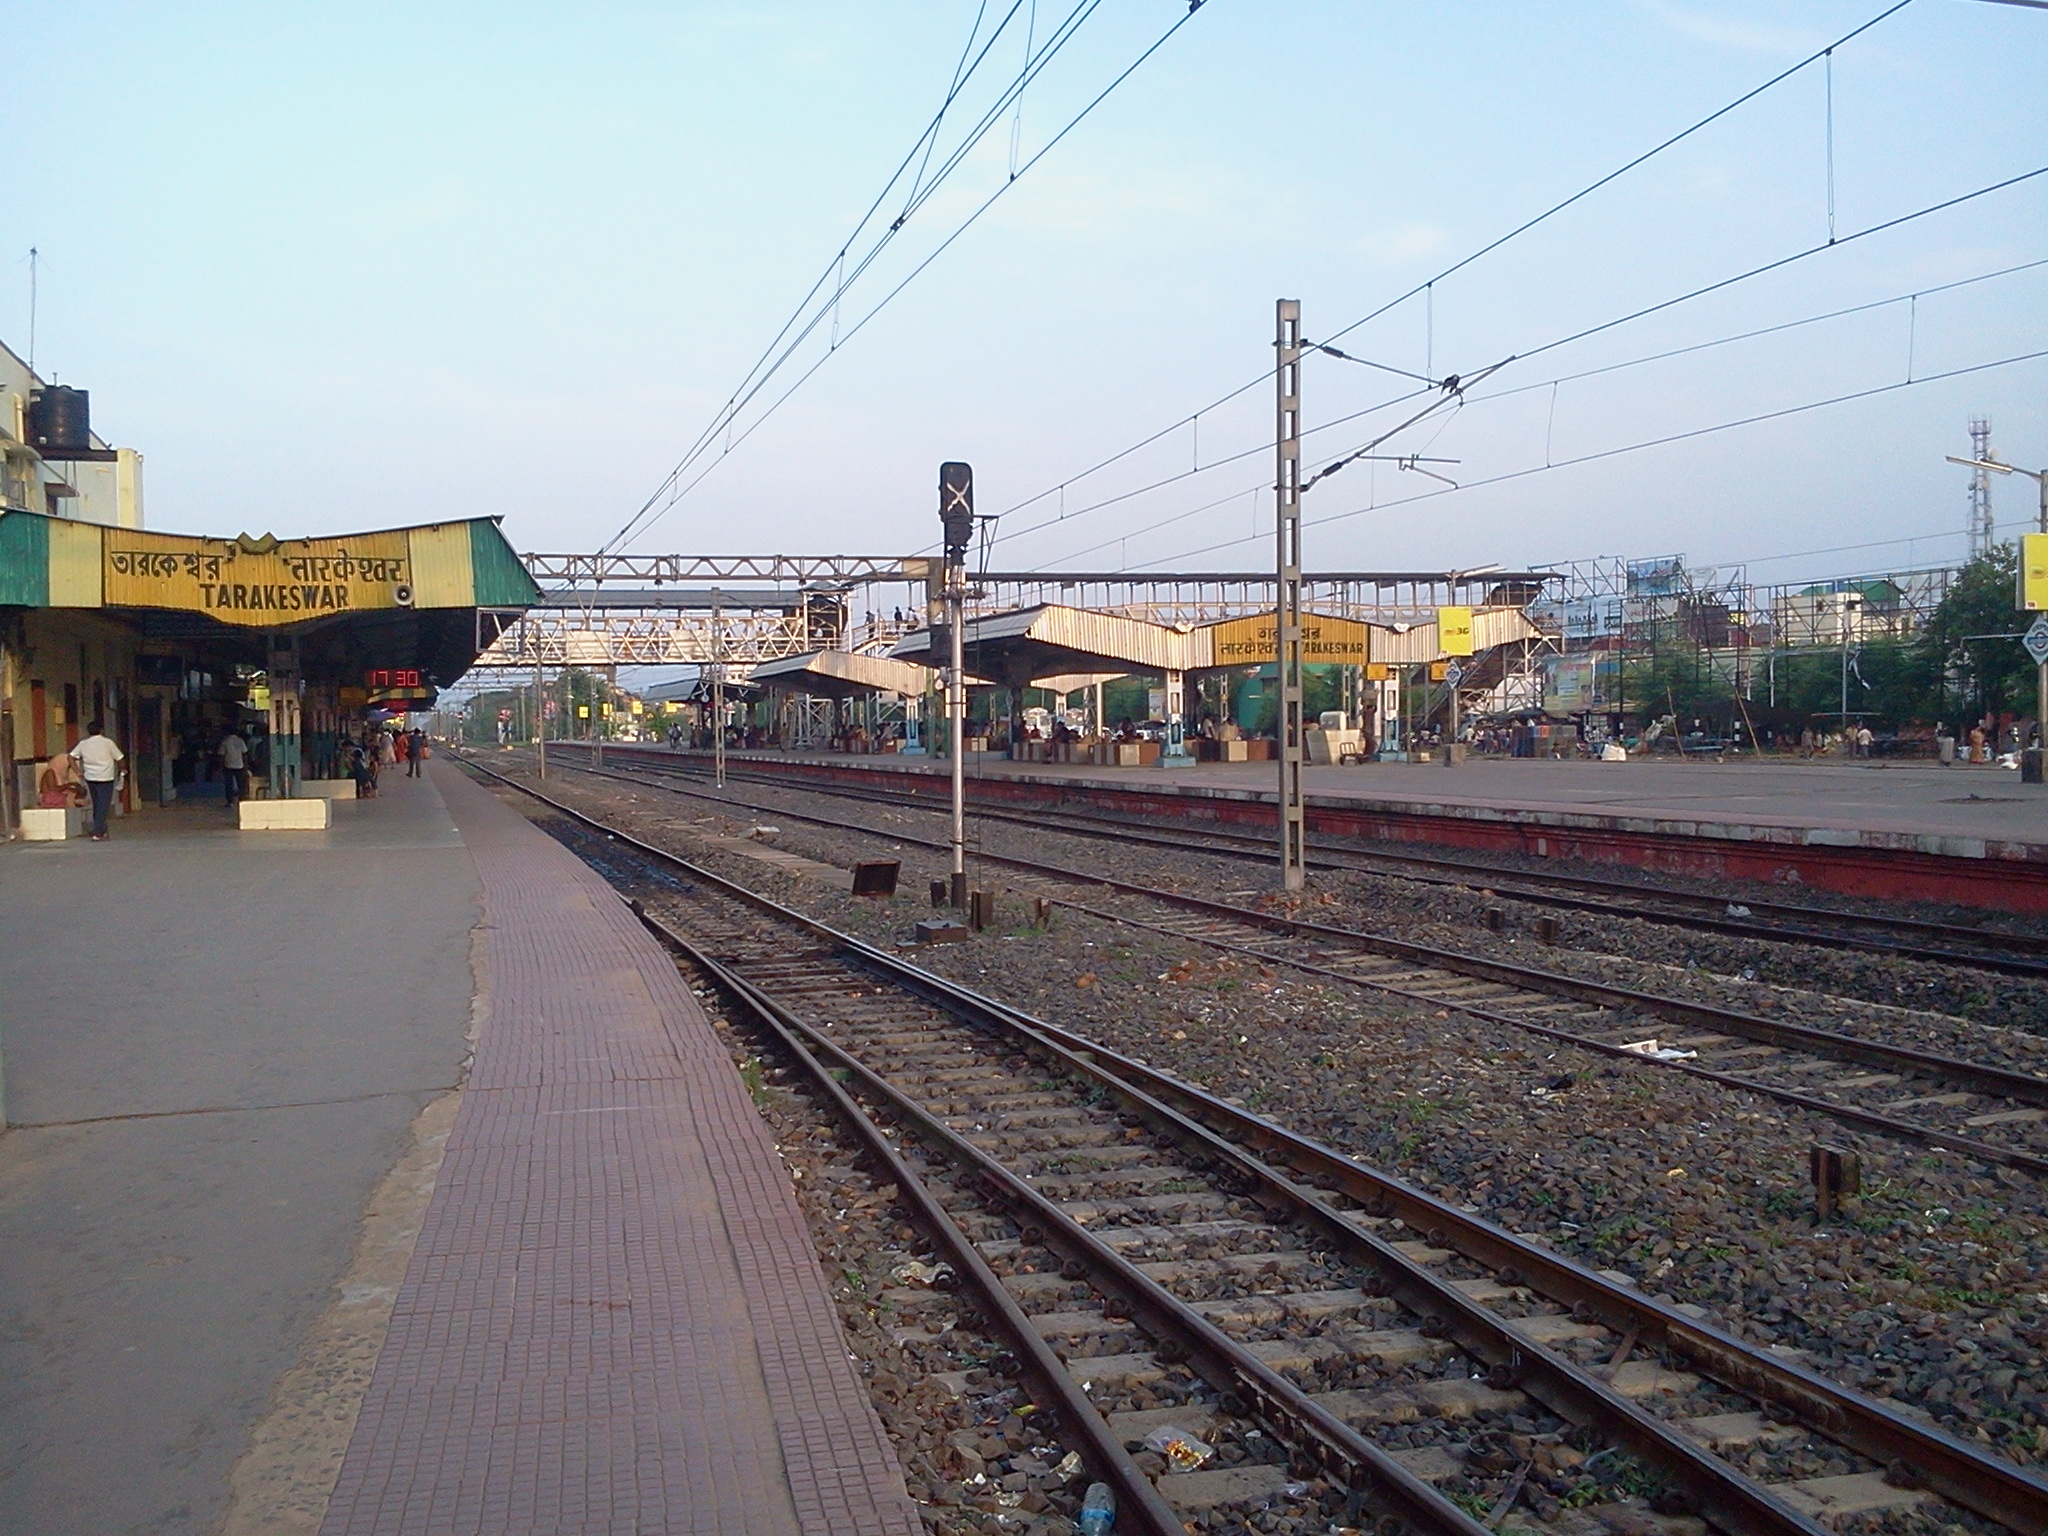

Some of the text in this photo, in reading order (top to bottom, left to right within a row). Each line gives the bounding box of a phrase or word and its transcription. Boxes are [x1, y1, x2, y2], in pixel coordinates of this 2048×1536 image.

[290, 547, 405, 582] तारकेश्वर
[199, 584, 349, 610] TARAKESWAR
[1301, 641, 1364, 654] ARAKESWAR
